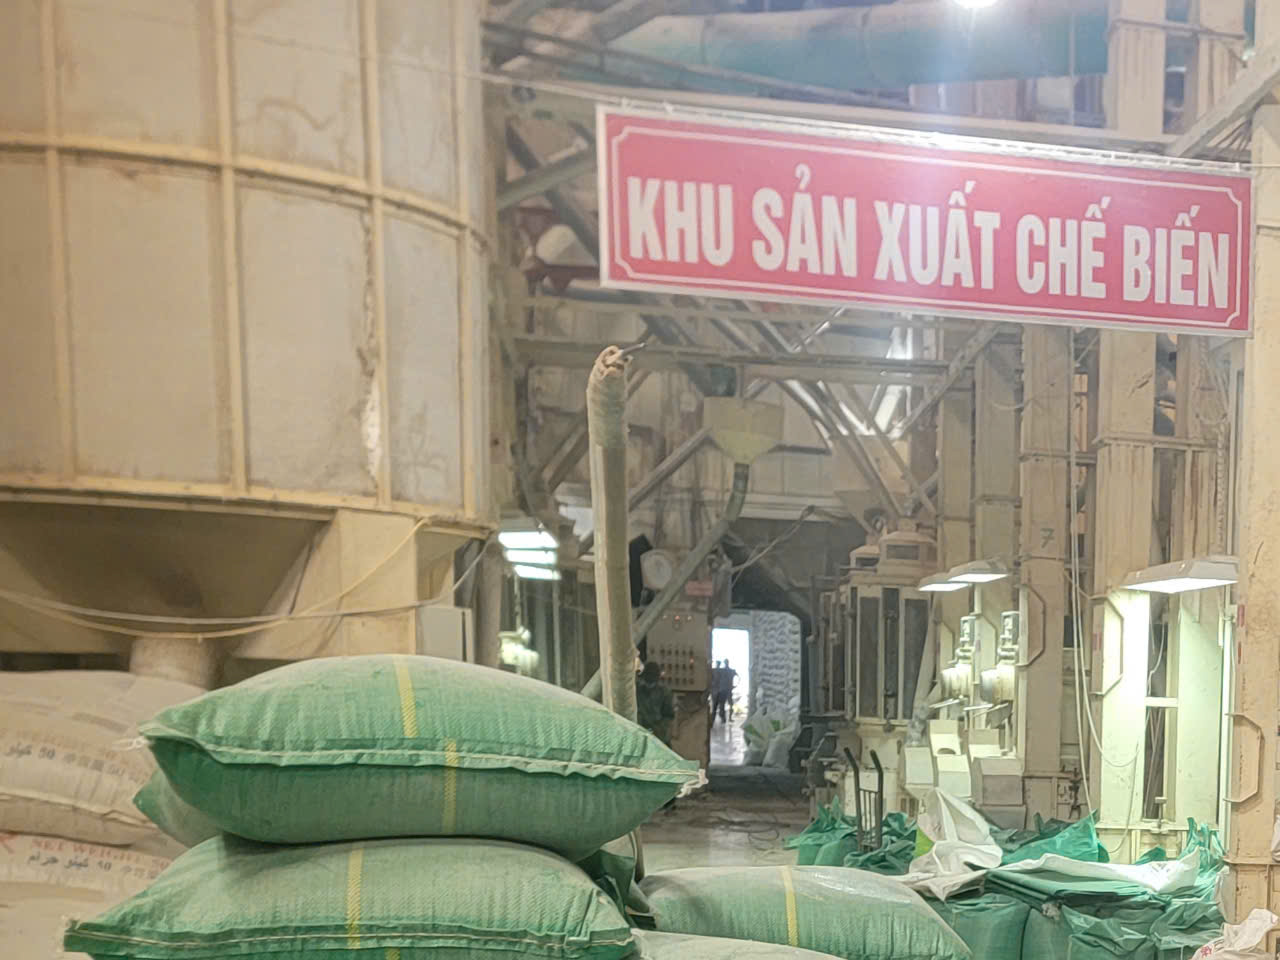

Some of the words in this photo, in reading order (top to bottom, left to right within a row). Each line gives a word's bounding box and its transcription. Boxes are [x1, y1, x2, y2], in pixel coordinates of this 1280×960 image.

[626, 176, 734, 267] KHU
[750, 163, 860, 278] SẢN
[873, 180, 1001, 291] XUẤT
[1015, 196, 1108, 299] CHẾ
[1122, 205, 1230, 310] BIẾN
